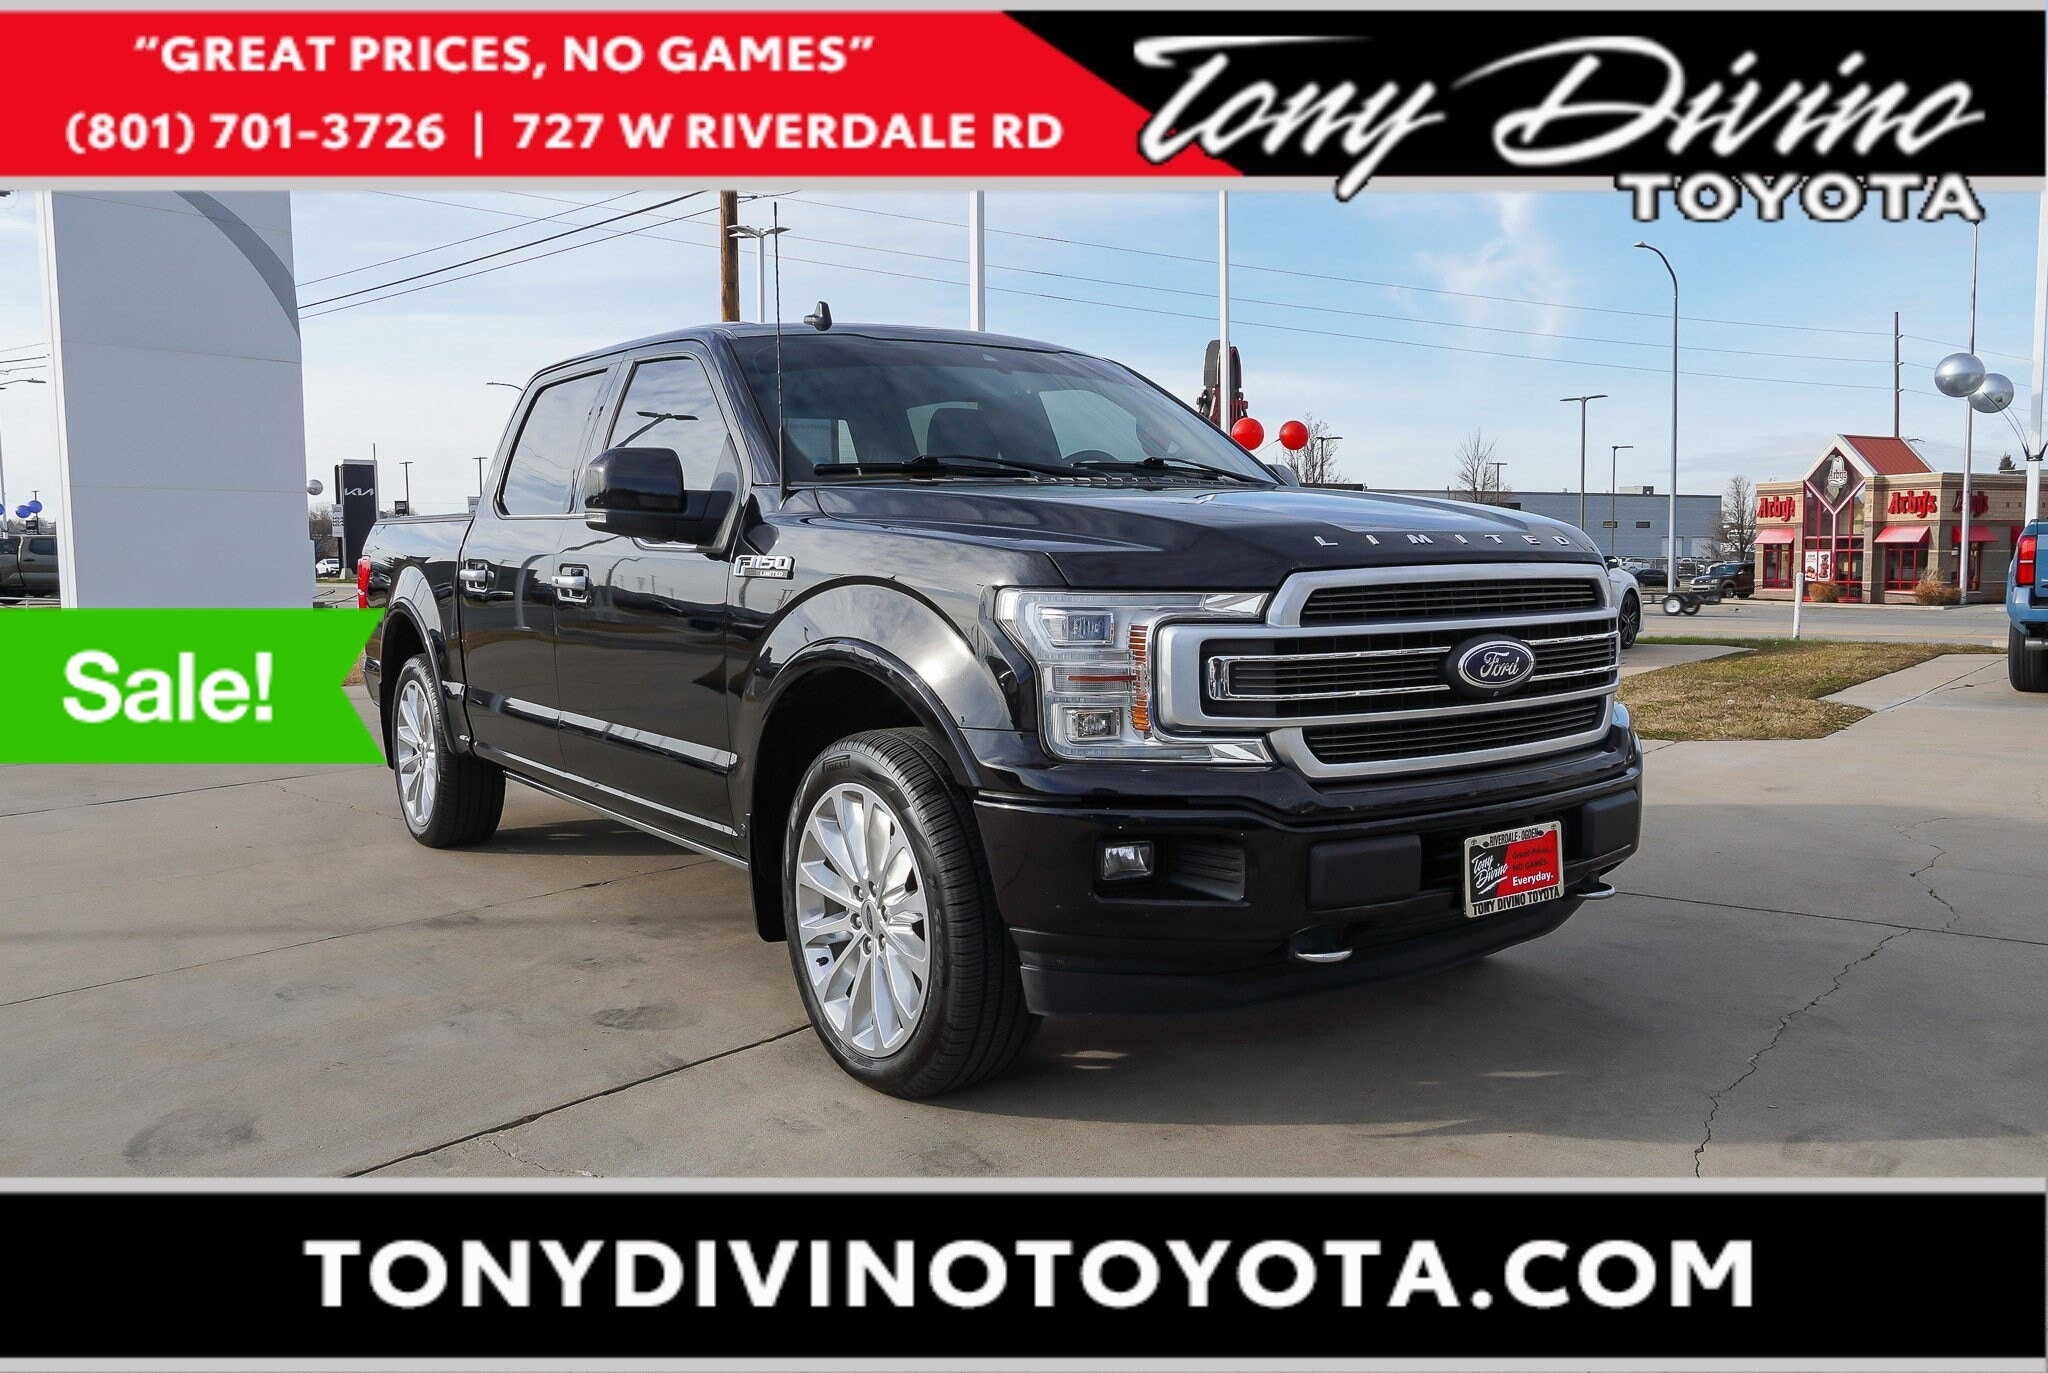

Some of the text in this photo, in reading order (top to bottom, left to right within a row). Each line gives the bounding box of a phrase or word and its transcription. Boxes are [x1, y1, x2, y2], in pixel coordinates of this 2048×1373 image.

[1757, 496, 1795, 522] Arby's
[1887, 490, 1937, 518] Arby's
[1314, 533, 1570, 547] LIMITED
[1480, 651, 1520, 678] Ford
[1489, 831, 1518, 847] RIVERDALE
[1471, 851, 1494, 874] Tony
[1473, 863, 1508, 889] Divino
[1512, 871, 1554, 887] Everyday.
[1472, 886, 1560, 916] TONY DIVINO TOYOTA
